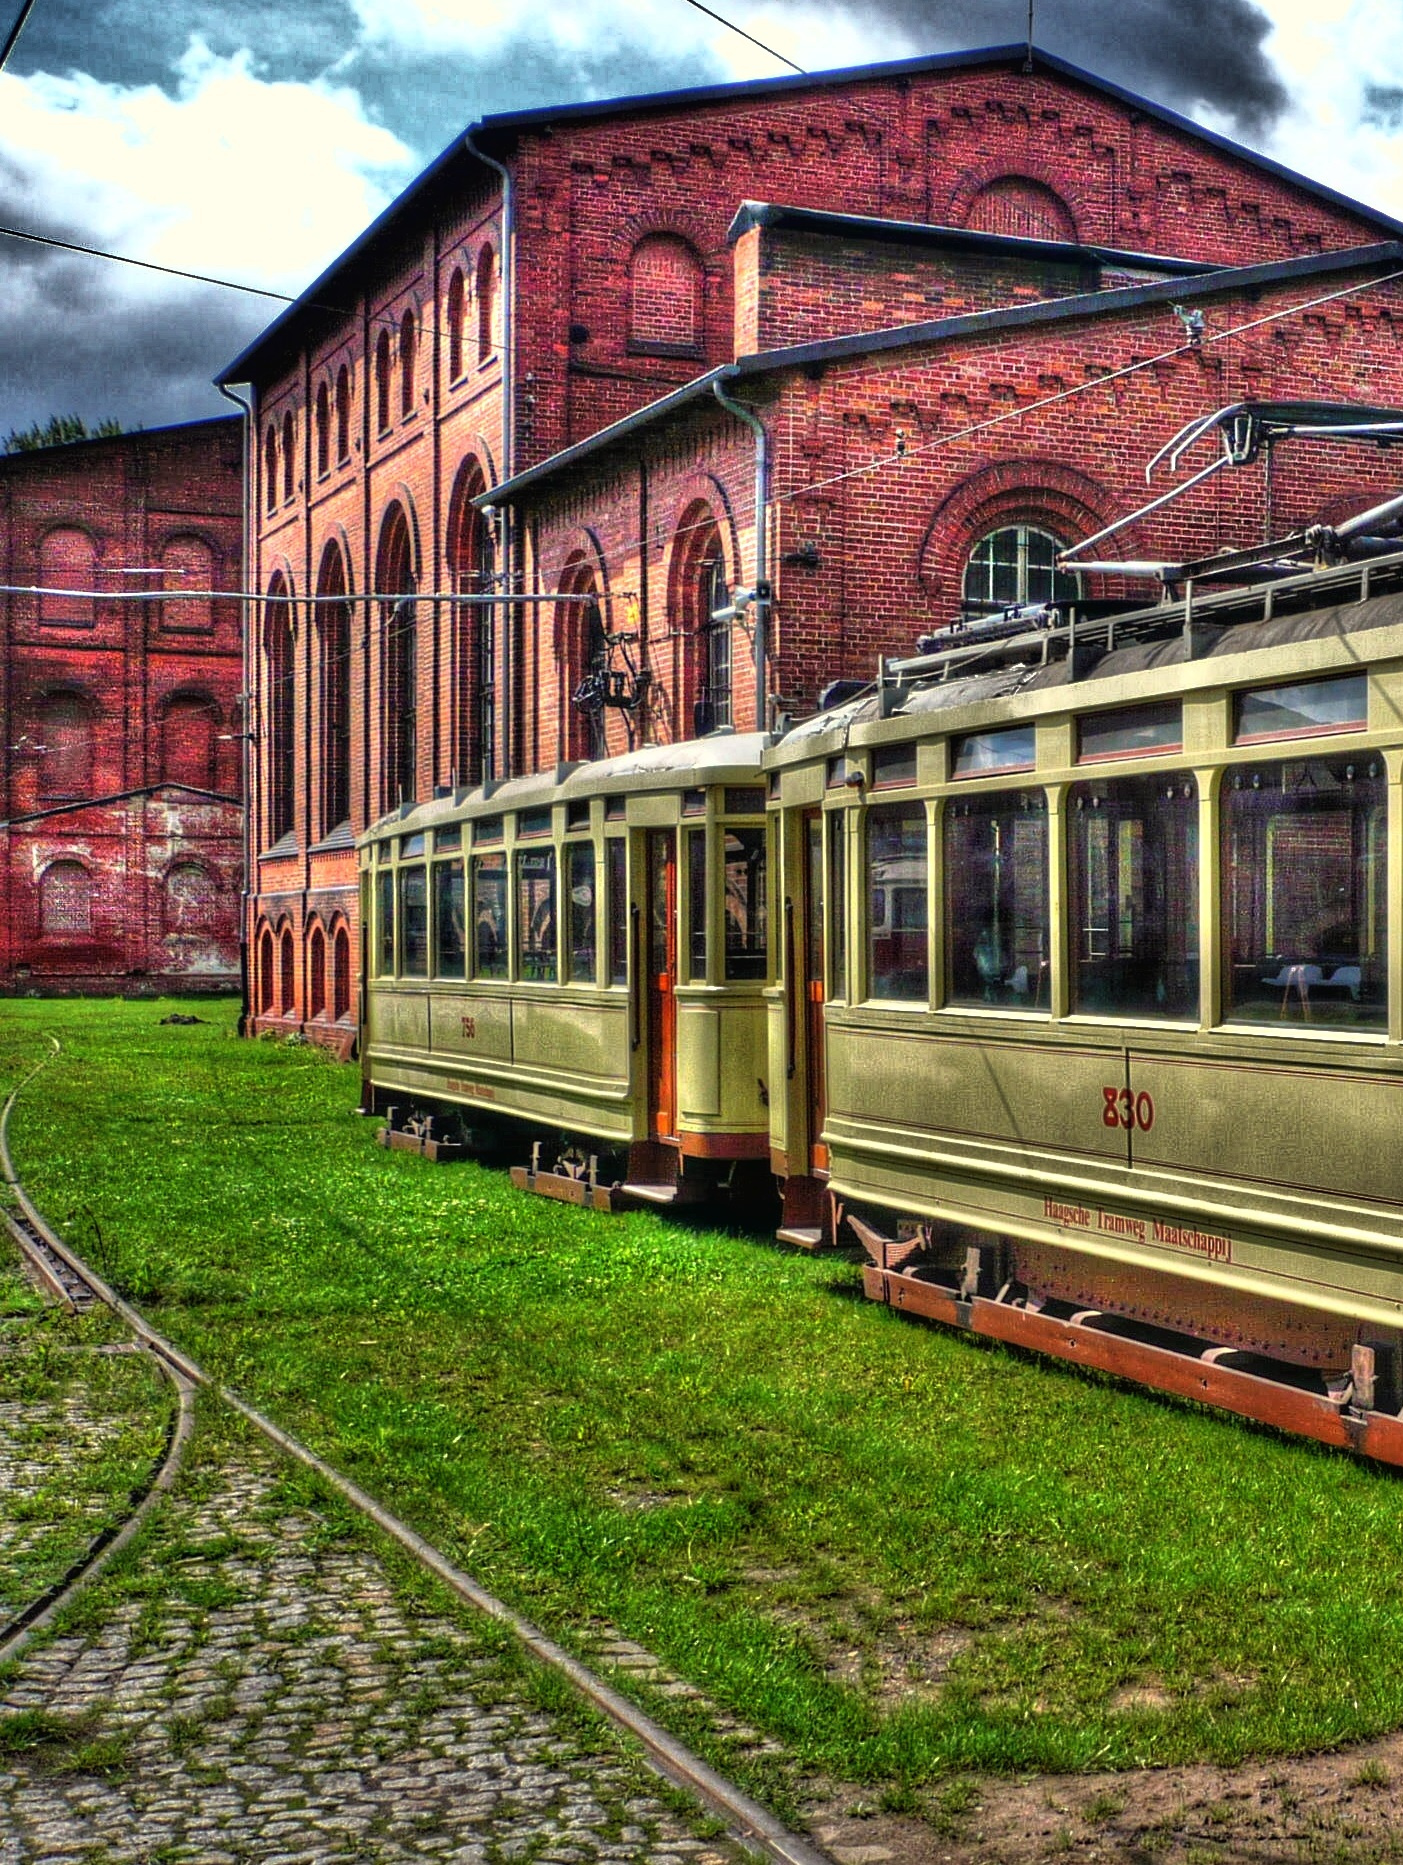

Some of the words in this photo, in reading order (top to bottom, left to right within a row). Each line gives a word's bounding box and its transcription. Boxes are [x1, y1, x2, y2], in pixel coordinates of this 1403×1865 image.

[1102, 1086, 1155, 1132] 830
[1043, 1195, 1091, 1228] Haagsche
[1096, 1205, 1146, 1244] Tramweg
[1151, 1216, 1233, 1264] Maatschappij
